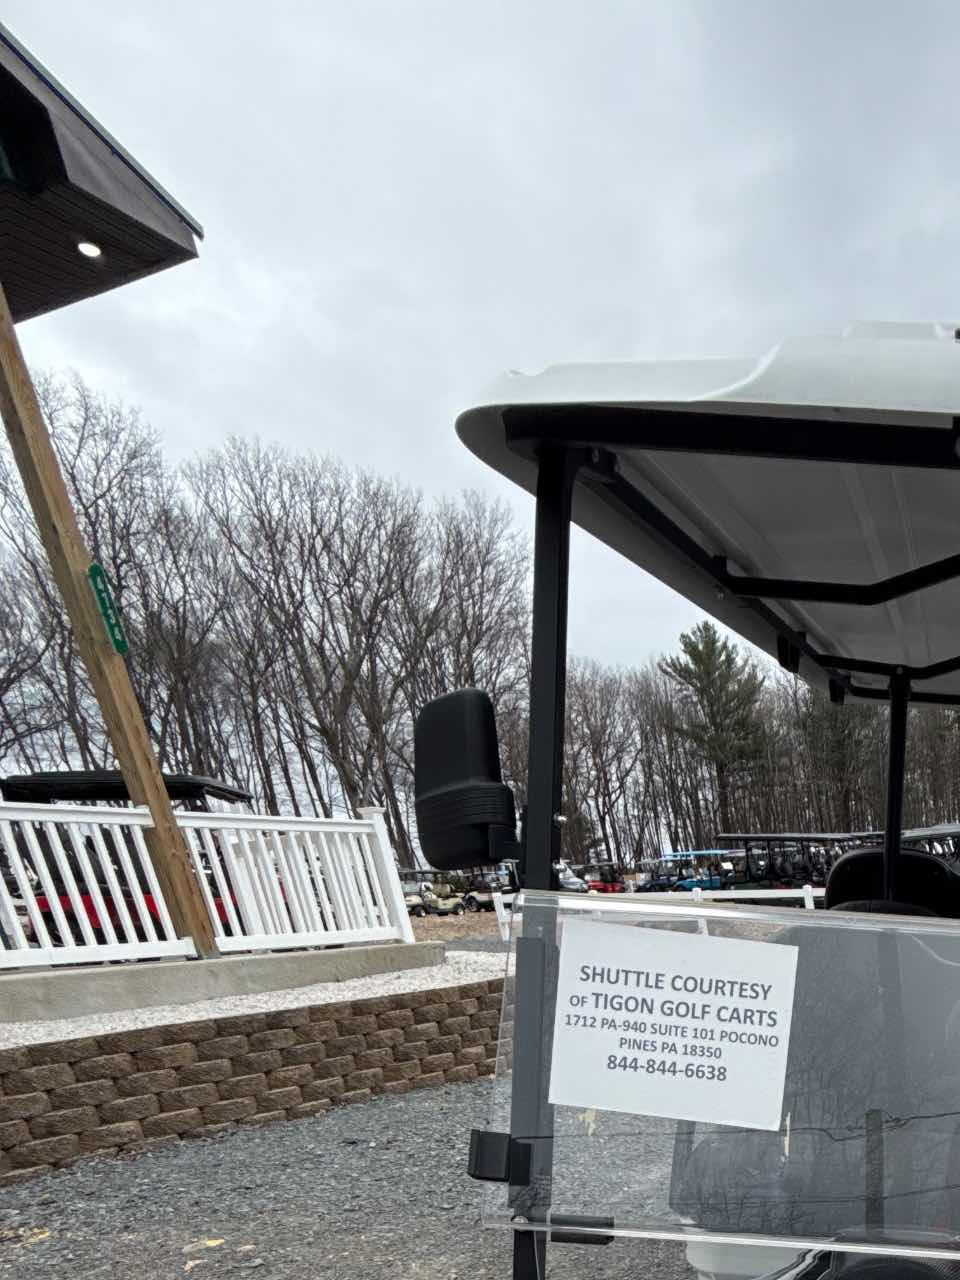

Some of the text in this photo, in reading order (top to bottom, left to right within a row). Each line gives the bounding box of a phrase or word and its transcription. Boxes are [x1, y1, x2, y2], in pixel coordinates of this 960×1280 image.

[580, 965, 772, 1001] SHUTTLE COURTESY
[569, 993, 777, 1027] OF TIGON GOLF CARTS
[565, 1014, 779, 1047] 1712 PA-940 SUITE 101 POCONO
[619, 1037, 722, 1059] PINES PA 18350
[607, 1055, 727, 1081] 844-844-6638
